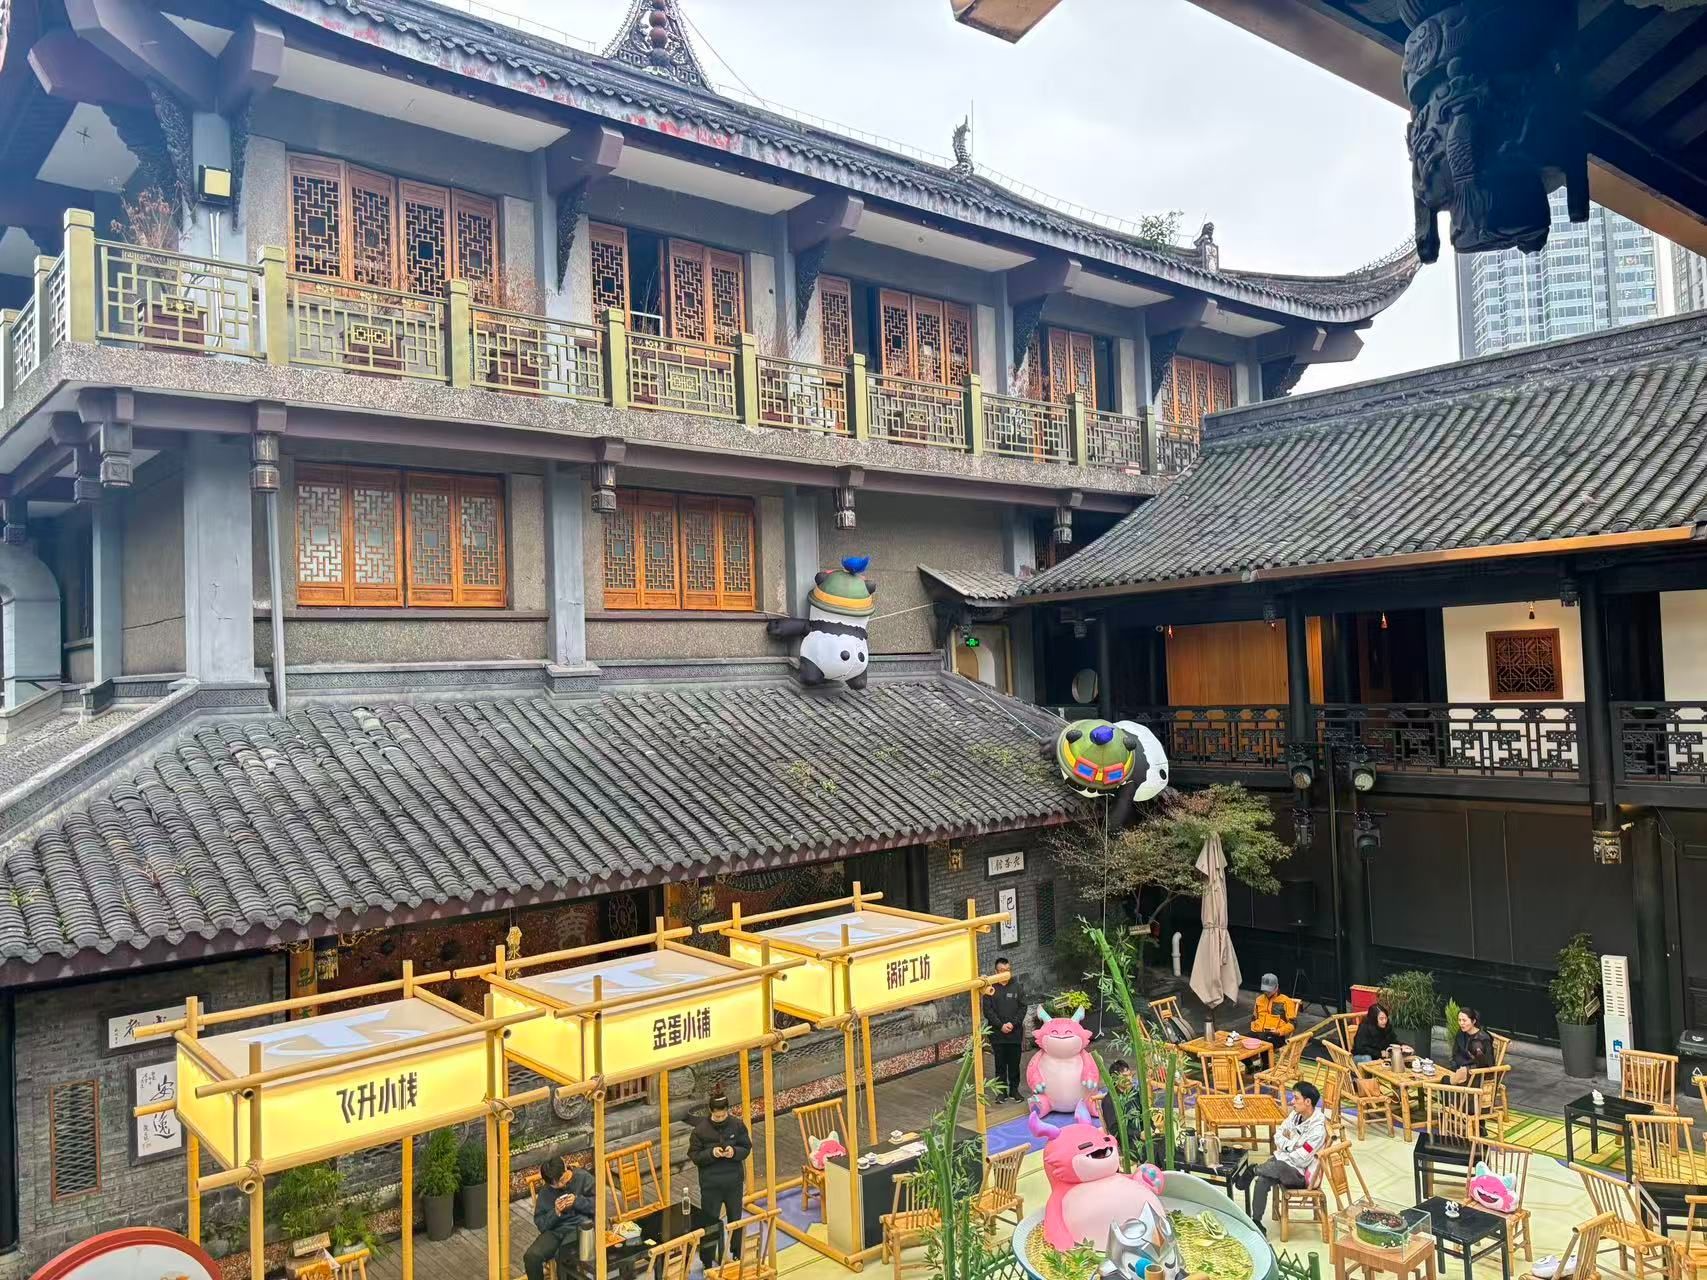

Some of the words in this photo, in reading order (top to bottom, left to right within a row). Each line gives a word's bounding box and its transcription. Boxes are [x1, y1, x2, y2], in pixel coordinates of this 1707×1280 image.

[886, 953, 930, 990] 锅铲工坊
[653, 1007, 711, 1051] 金蛋小铺
[336, 1072, 418, 1124] 飞升小栈
